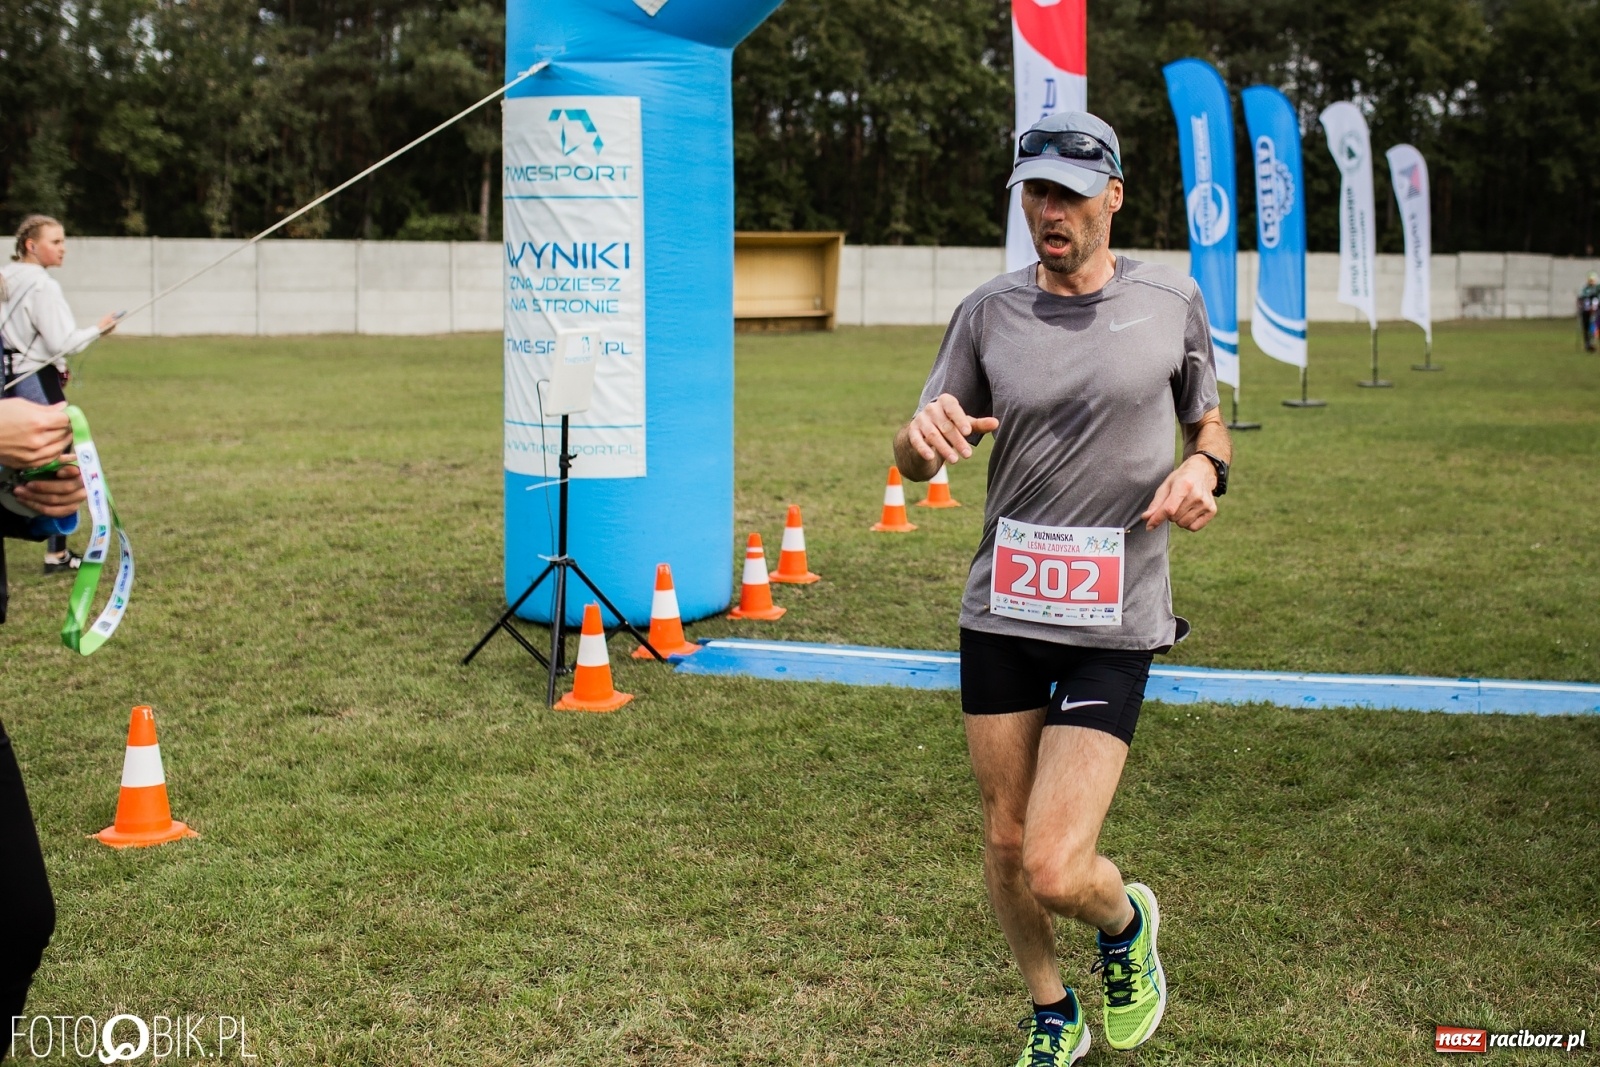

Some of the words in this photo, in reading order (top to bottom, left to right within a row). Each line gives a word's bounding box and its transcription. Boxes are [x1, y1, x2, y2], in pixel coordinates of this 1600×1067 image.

[506, 241, 630, 270] WYNIKI
[510, 276, 621, 292] ZNAJDZIESZ
[511, 298, 528, 312] NA
[532, 299, 620, 314] STRONIE
[1027, 541, 1047, 551] LEŚNA
[1048, 543, 1081, 554] ZADYSZKA
[1010, 555, 1100, 601] 202
